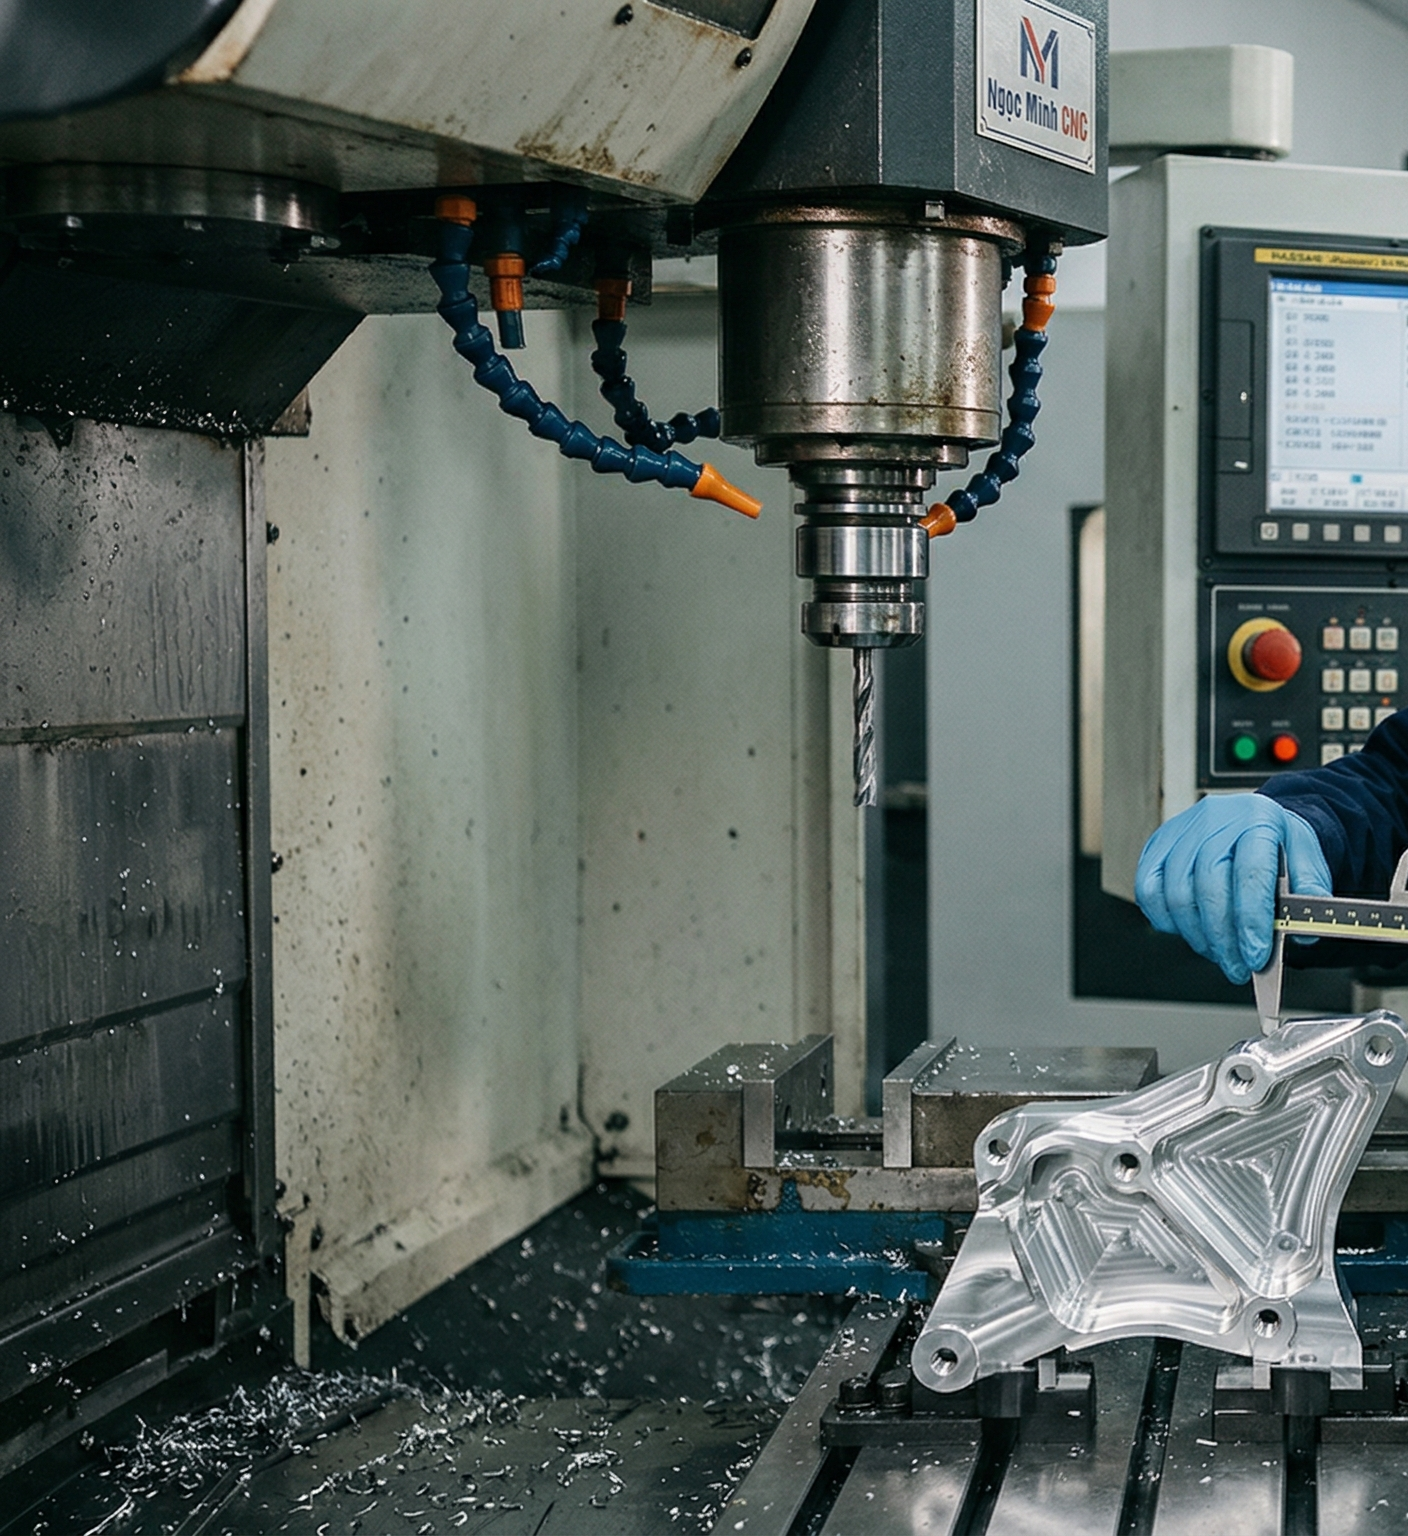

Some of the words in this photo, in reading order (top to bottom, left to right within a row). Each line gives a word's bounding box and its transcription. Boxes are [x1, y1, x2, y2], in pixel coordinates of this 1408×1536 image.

[987, 77, 1022, 121] Ngọc
[1025, 91, 1058, 132] Minh
[1061, 105, 1088, 141] CNC
